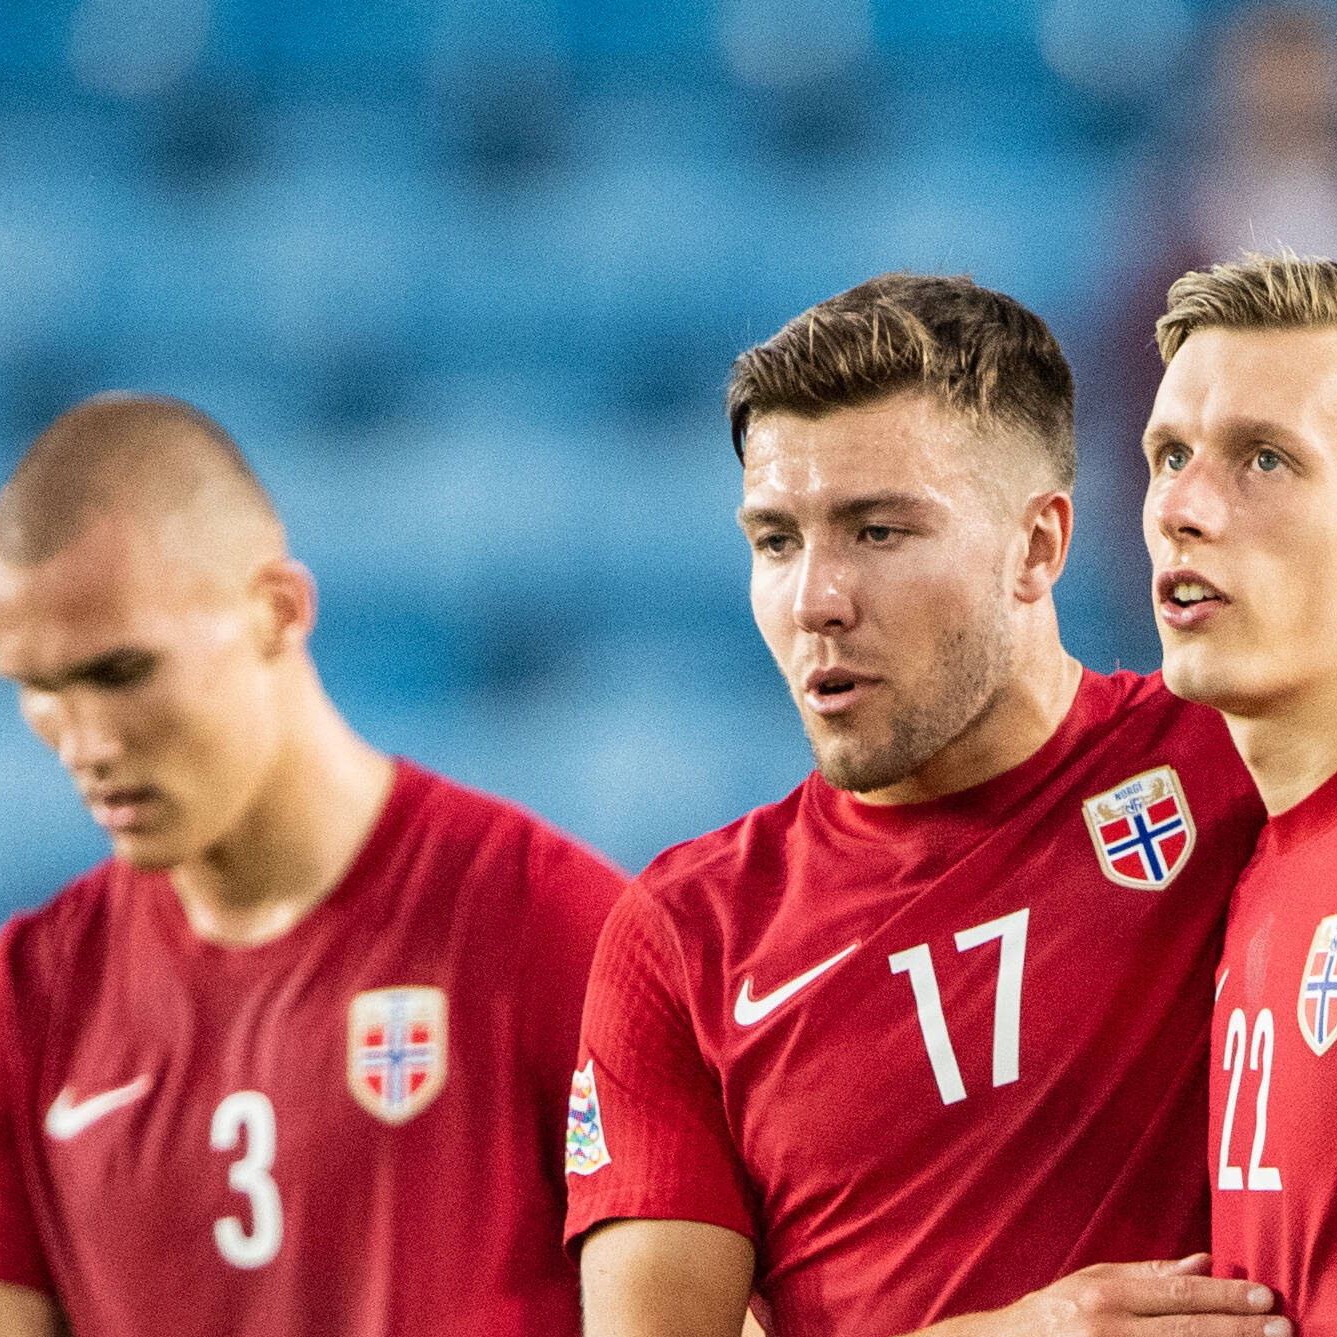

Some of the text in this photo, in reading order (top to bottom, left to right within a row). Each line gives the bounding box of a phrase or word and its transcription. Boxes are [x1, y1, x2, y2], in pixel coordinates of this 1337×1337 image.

[888, 908, 1029, 1106] 17
[210, 1091, 283, 1270] 3
[1218, 1008, 1283, 1191] 22
